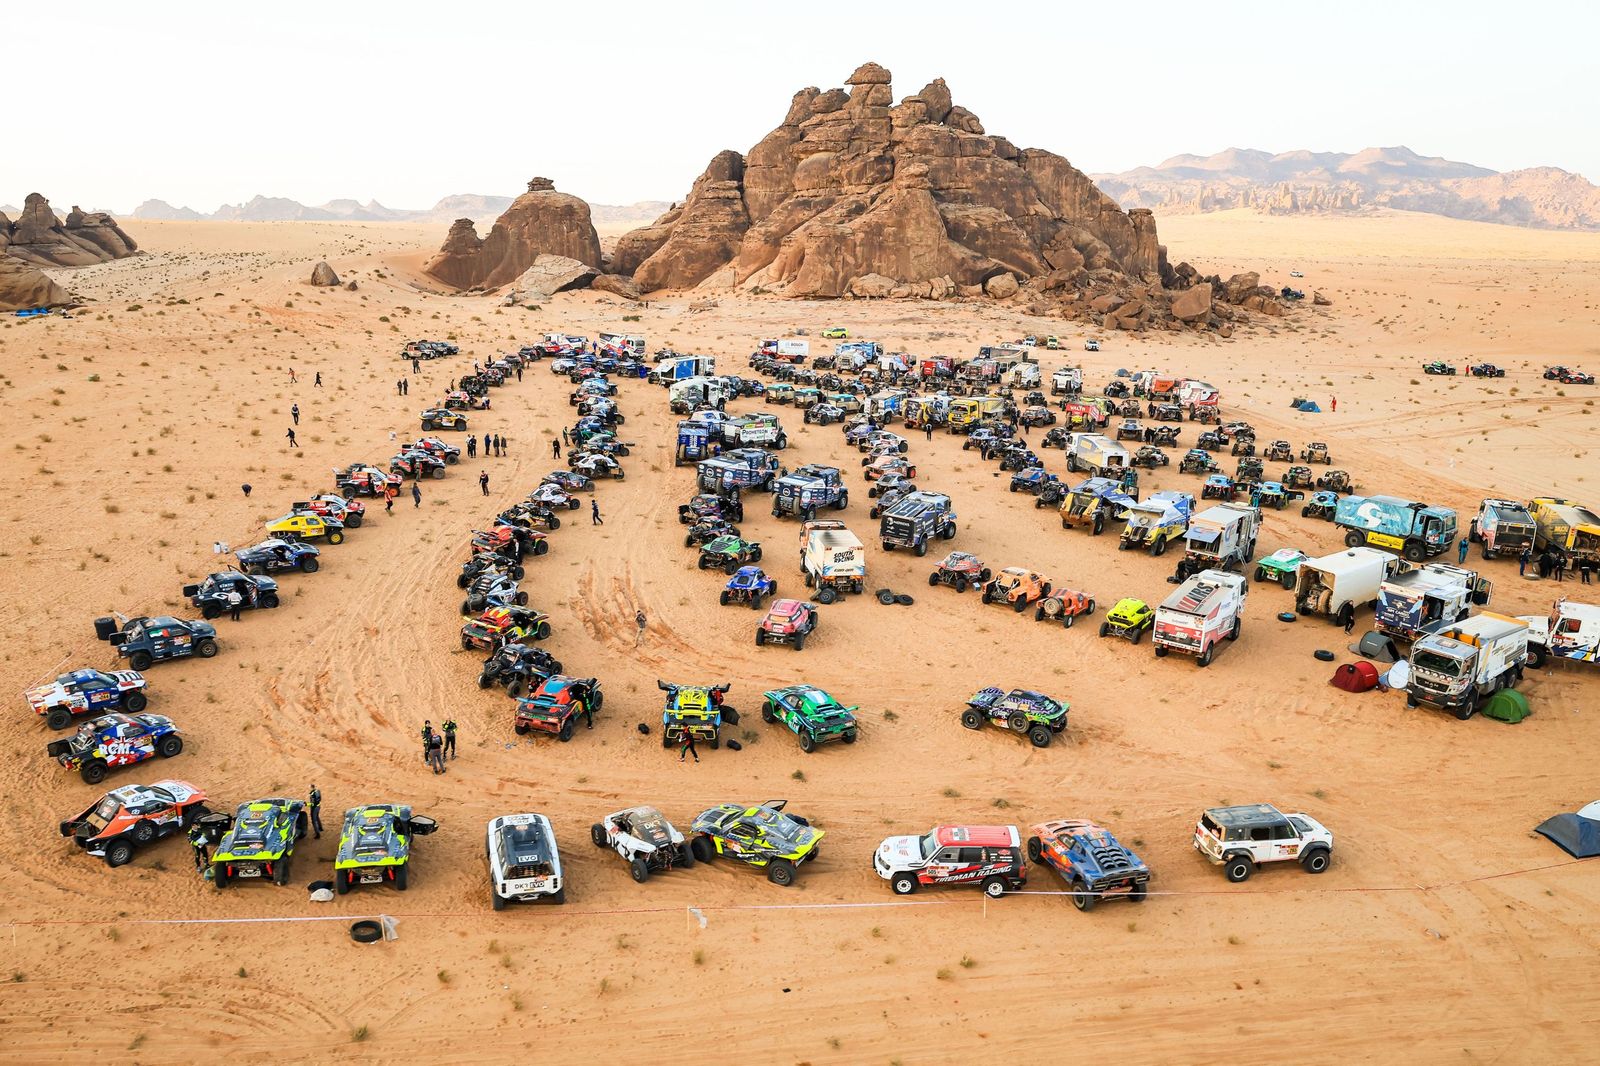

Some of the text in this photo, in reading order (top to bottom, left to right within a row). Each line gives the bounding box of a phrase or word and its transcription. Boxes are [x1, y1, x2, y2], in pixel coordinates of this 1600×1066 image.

[833, 550, 854, 559] SOUTH
[833, 555, 855, 563] RACING
[934, 871, 976, 882] TIREMAN
[976, 865, 1013, 877] RACING
